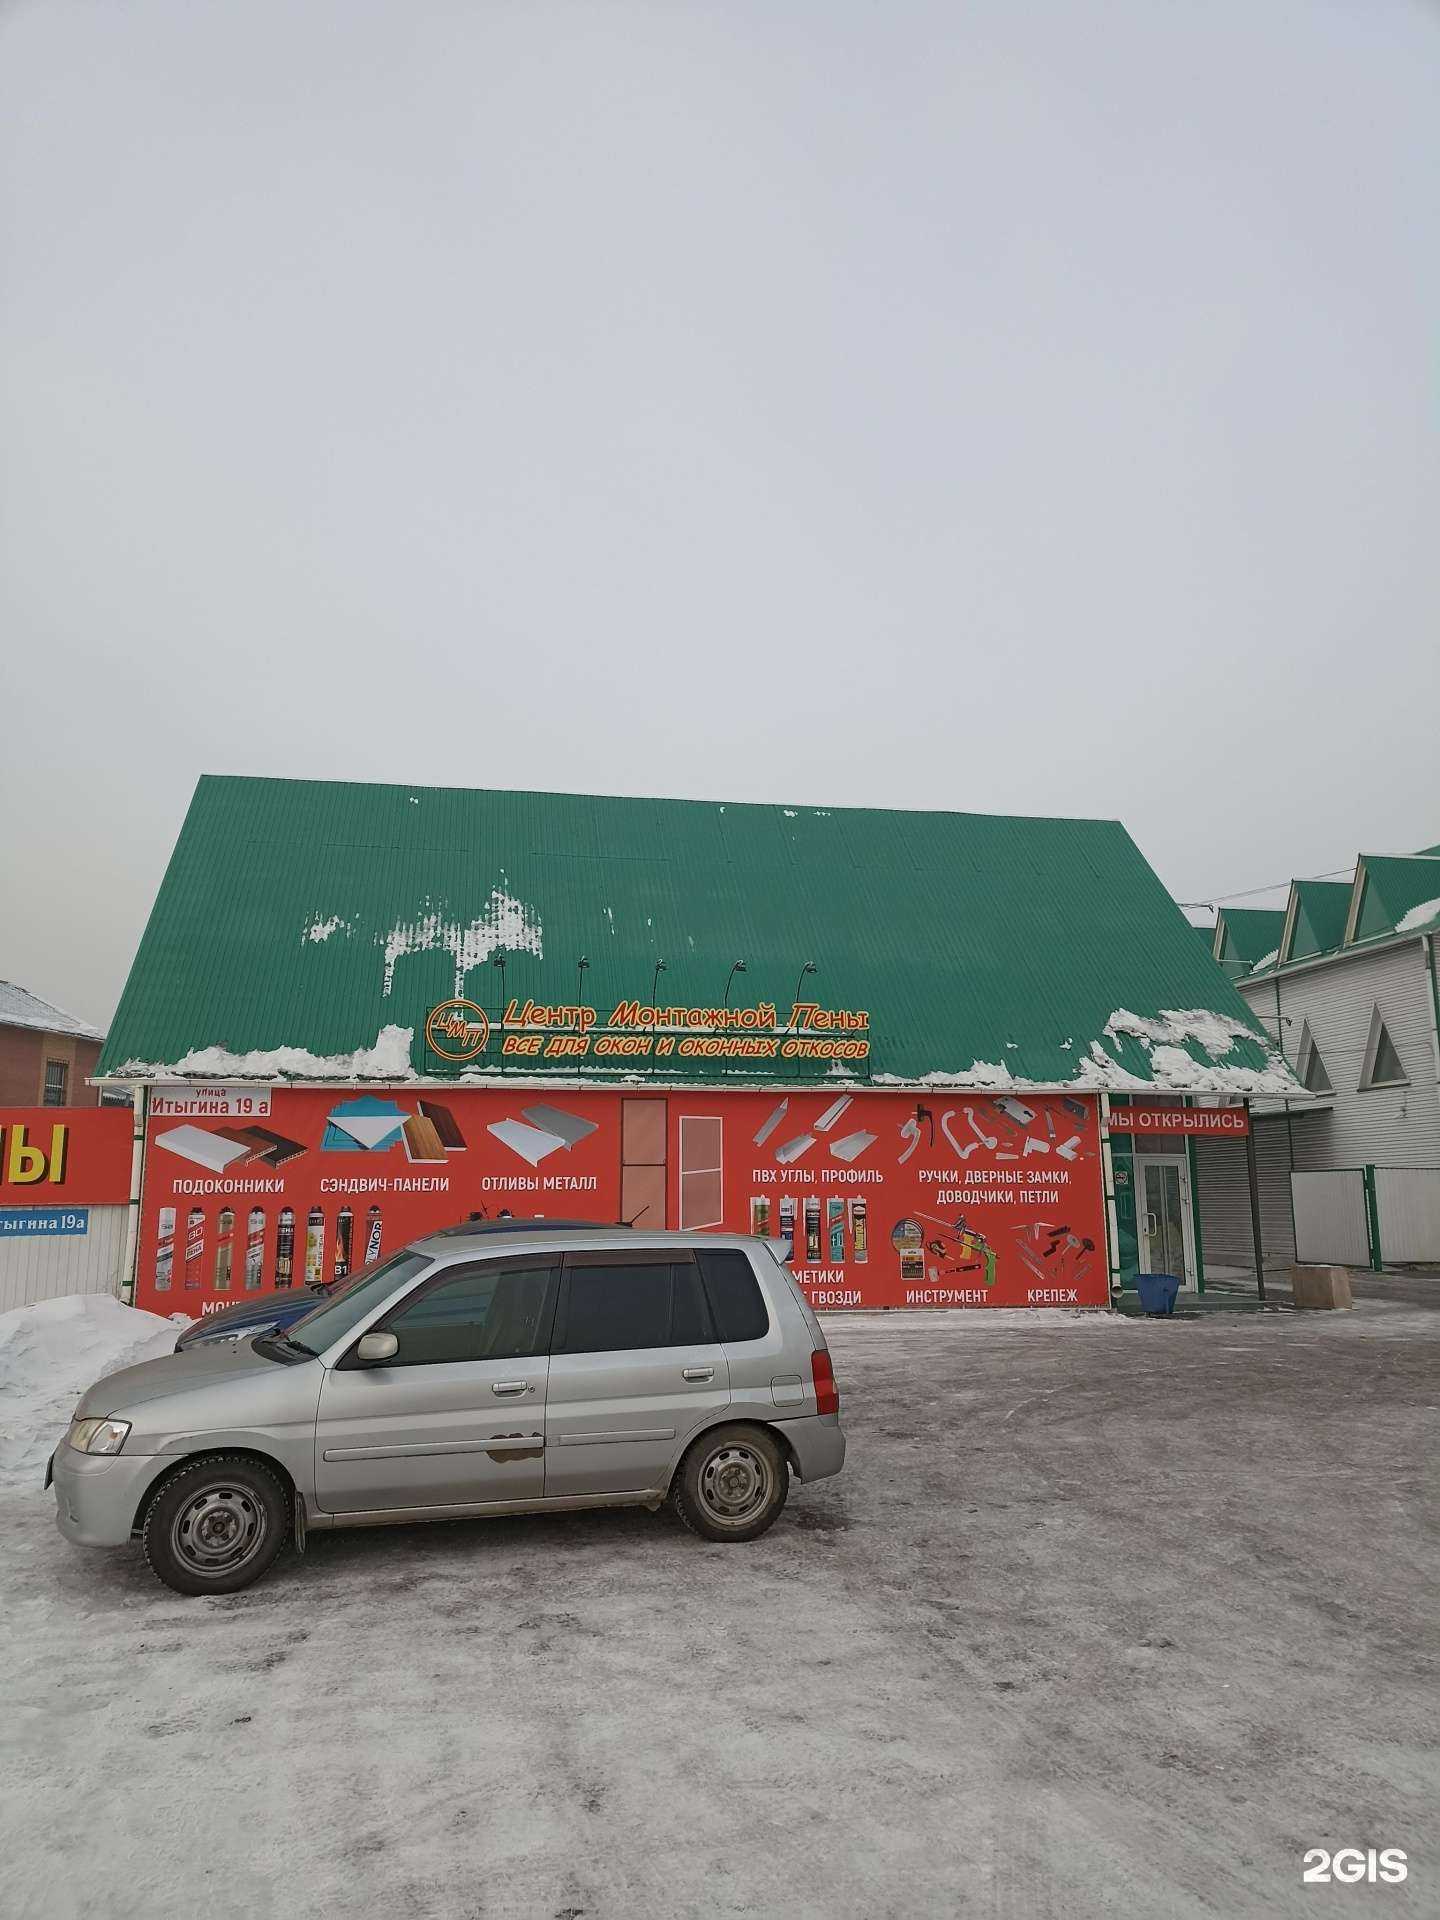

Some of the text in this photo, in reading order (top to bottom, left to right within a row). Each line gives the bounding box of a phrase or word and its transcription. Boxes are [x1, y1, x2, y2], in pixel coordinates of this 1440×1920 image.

[502, 999, 869, 1032] Центр Монтажной Пены
[437, 1011, 482, 1046] ЦМП
[502, 1036, 870, 1059] ВСЕ ДЛЯ ОКОН И ОКОННЫХ ОТКОСОВ
[196, 1088, 226, 1098] улица
[152, 1097, 268, 1114] Итыгина 19 а
[1138, 1112, 1244, 1128] ОТКРЫЛИСЬ
[0, 1124, 66, 1183] Ы
[320, 1177, 449, 1193] СЭНДВИЧ-ПАНЕЛИ
[481, 1176, 597, 1191] ОТЛИВЫ МЕТАЛЛ
[752, 1169, 884, 1185] ПВХ УГЛЫ, ПРОФИЛЬ
[918, 1169, 962, 1185] РУЧКИ,
[964, 1170, 1023, 1184] ДВЕРНЫЕ
[172, 1179, 285, 1195] ПОДОКОННИКИ
[936, 1190, 1059, 1206] ДОВОДЧИКИ, ПЕТЛИ
[792, 1270, 844, 1283] МЕТИКИ
[812, 1291, 861, 1305] ГВОЗДИ
[906, 1289, 988, 1303] ИНСТРУМЕНТ
[1027, 1289, 1078, 1302] КРЕПЕЖ
